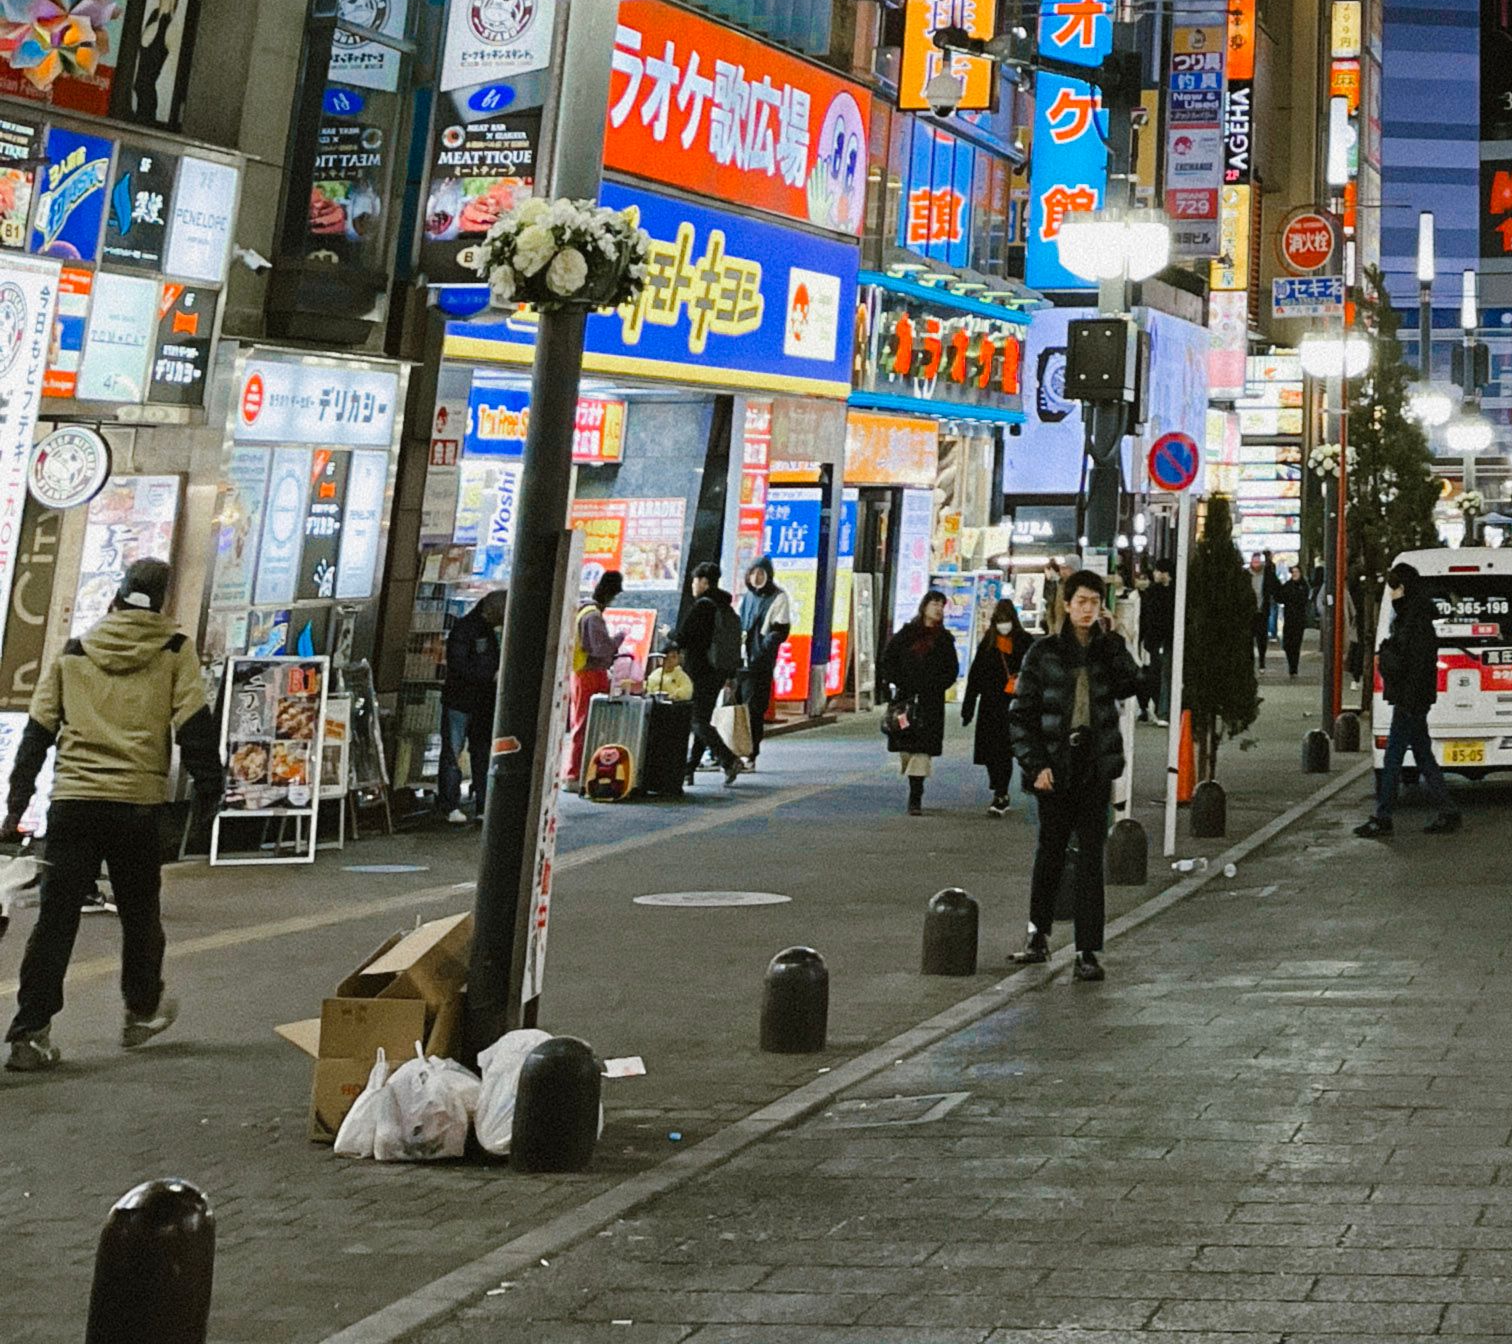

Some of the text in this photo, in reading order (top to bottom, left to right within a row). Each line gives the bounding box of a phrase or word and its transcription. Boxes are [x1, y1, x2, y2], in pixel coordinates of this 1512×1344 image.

[1173, 92, 1200, 100] New
[611, 25, 811, 188] ラオケ歌広場
[1184, 100, 1220, 110] Used
[1229, 88, 1250, 169] AGEHA
[438, 150, 532, 170] MEAT TIQUE
[1176, 201, 1210, 214] 729
[5, 224, 19, 238] B1
[1288, 233, 1329, 254] 消火栓
[1452, 749, 1484, 762] 85-05
